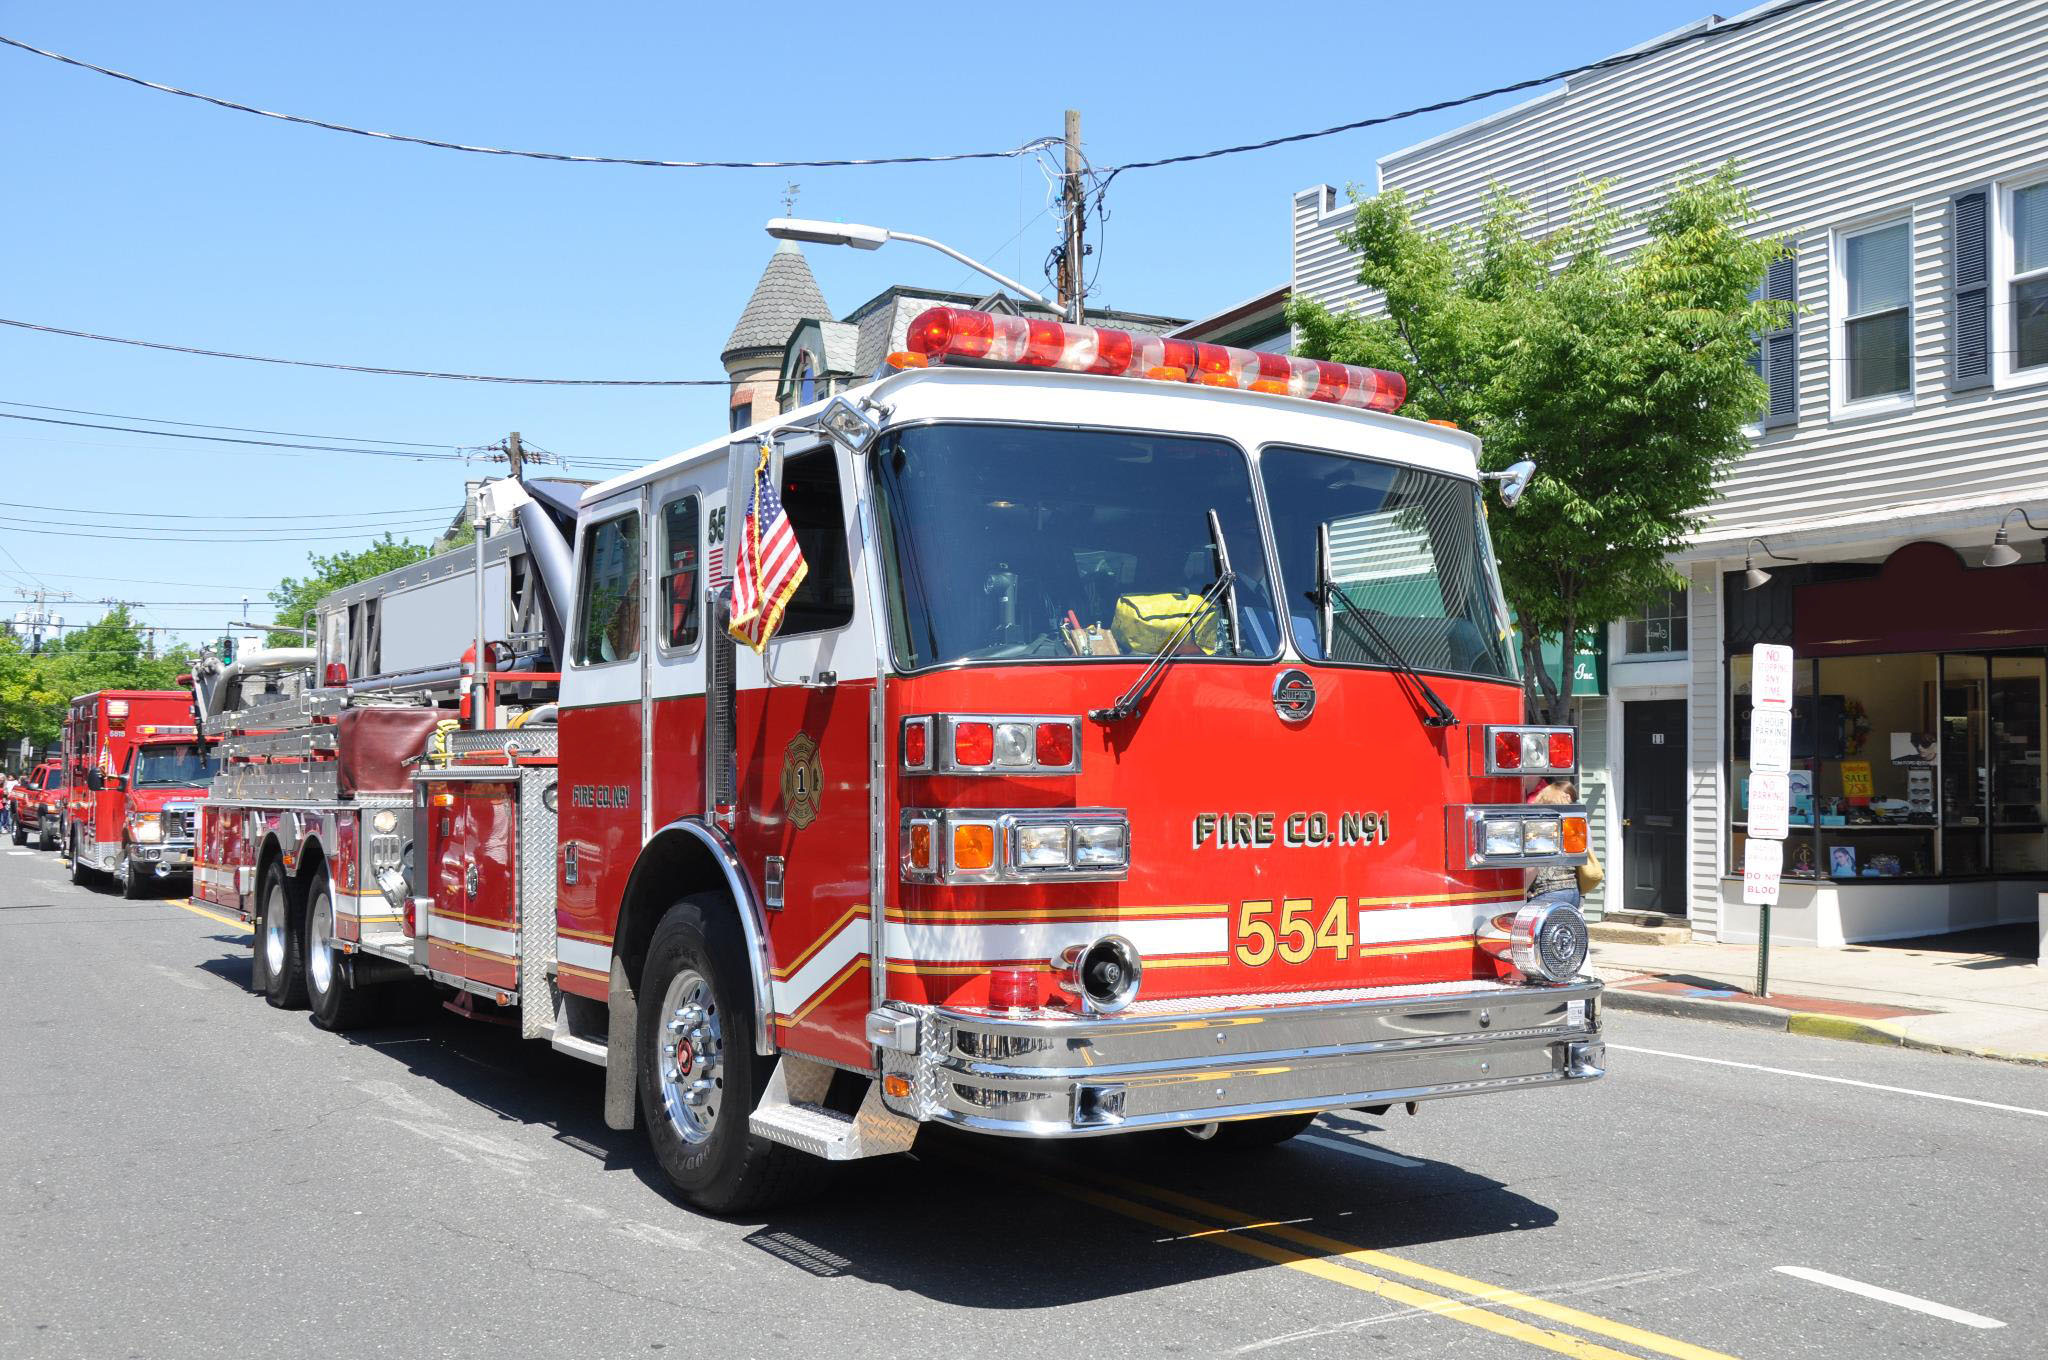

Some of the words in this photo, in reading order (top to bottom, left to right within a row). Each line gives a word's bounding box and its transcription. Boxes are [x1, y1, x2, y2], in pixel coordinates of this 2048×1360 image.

[1766, 649, 1780, 662] NO
[1758, 662, 1790, 673] STOPPING
[1765, 674, 1780, 684] ANY
[1763, 686, 1781, 696] TIME
[1765, 717, 1784, 727] HOUR
[1755, 726, 1787, 737] PARKING
[797, 767, 807, 794] 1
[1844, 774, 1869, 782] SALE
[1762, 780, 1775, 791] NO
[572, 784, 595, 808] FIRE
[1752, 791, 1784, 801] PARKING
[1192, 812, 1276, 850] FIRE
[1283, 811, 1336, 849] CO.
[1746, 872, 1761, 880] DO
[1234, 896, 1354, 967] 554
